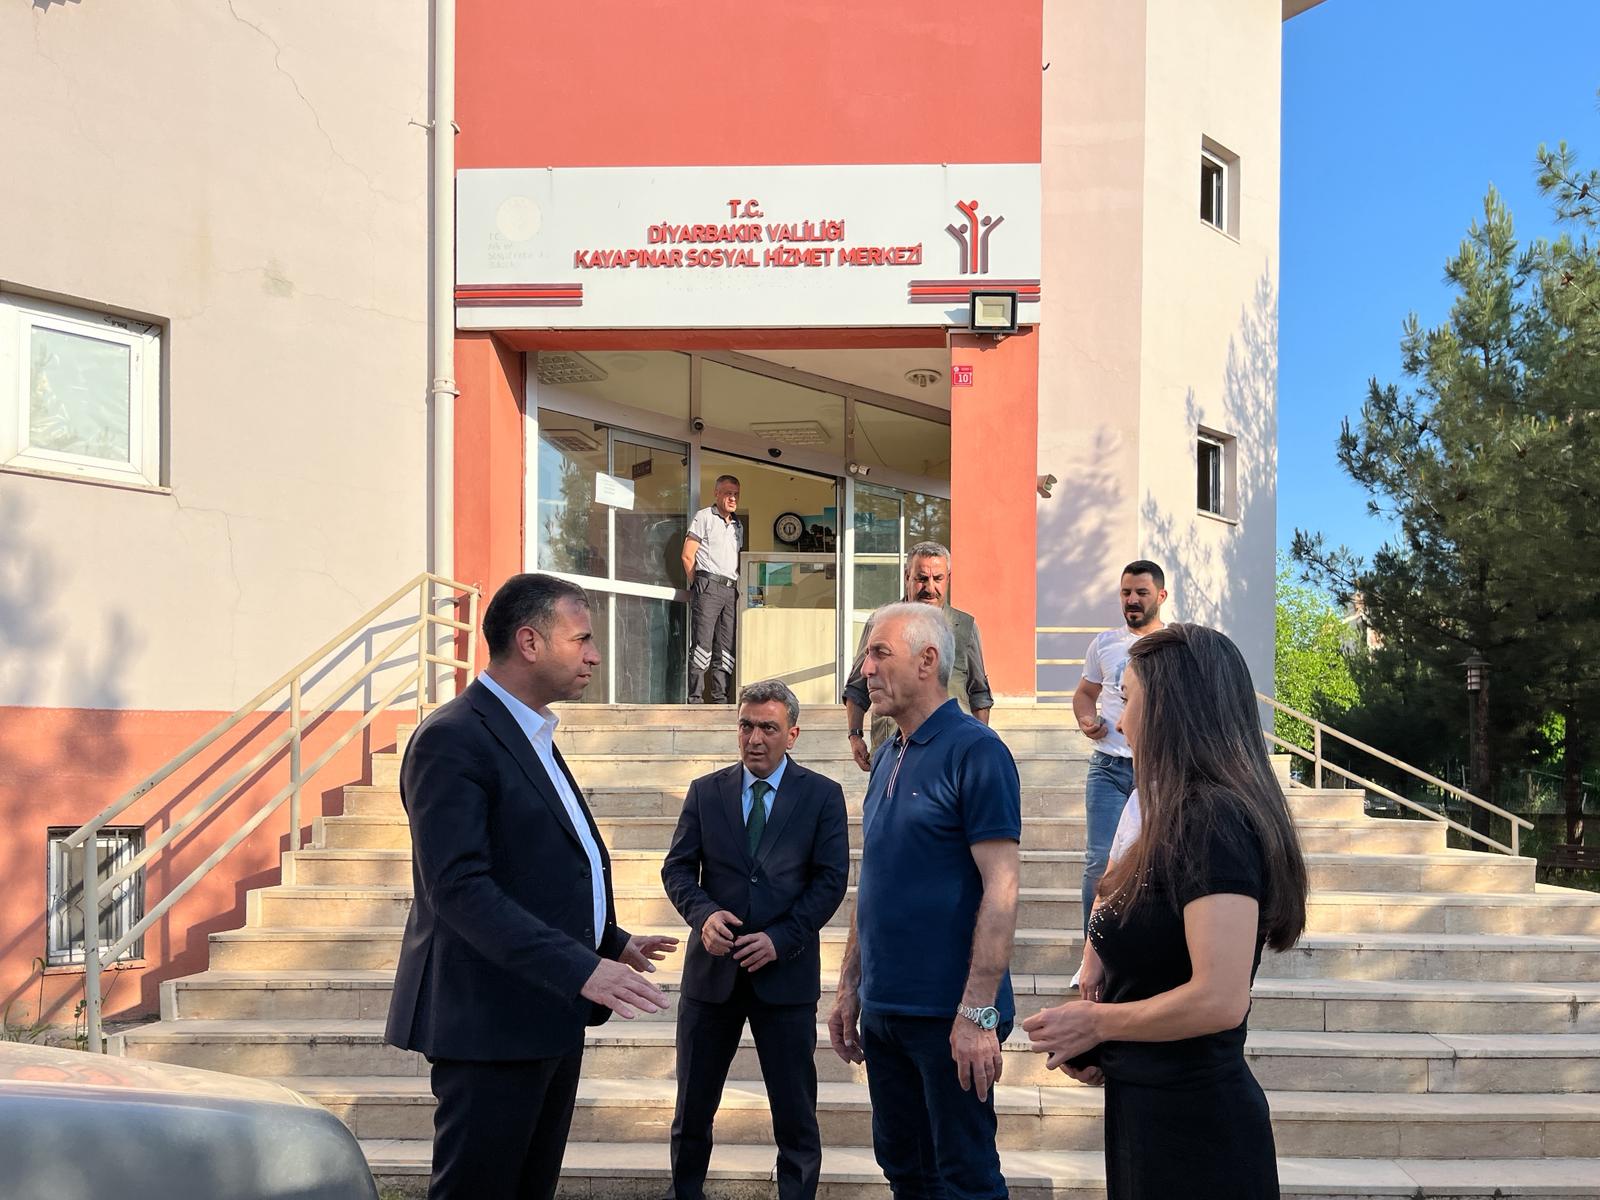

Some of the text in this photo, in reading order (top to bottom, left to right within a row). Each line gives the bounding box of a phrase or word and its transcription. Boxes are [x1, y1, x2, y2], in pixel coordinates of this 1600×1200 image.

[728, 199, 764, 218] T.C.
[648, 219, 845, 243] DİYARBAKIR VALİLİĞİ
[574, 249, 684, 269] KAYAPINAR
[685, 248, 761, 268] SOSYAL
[763, 244, 835, 268] HİZMET
[838, 242, 922, 267] MERKEZİ
[958, 374, 969, 382] 10
